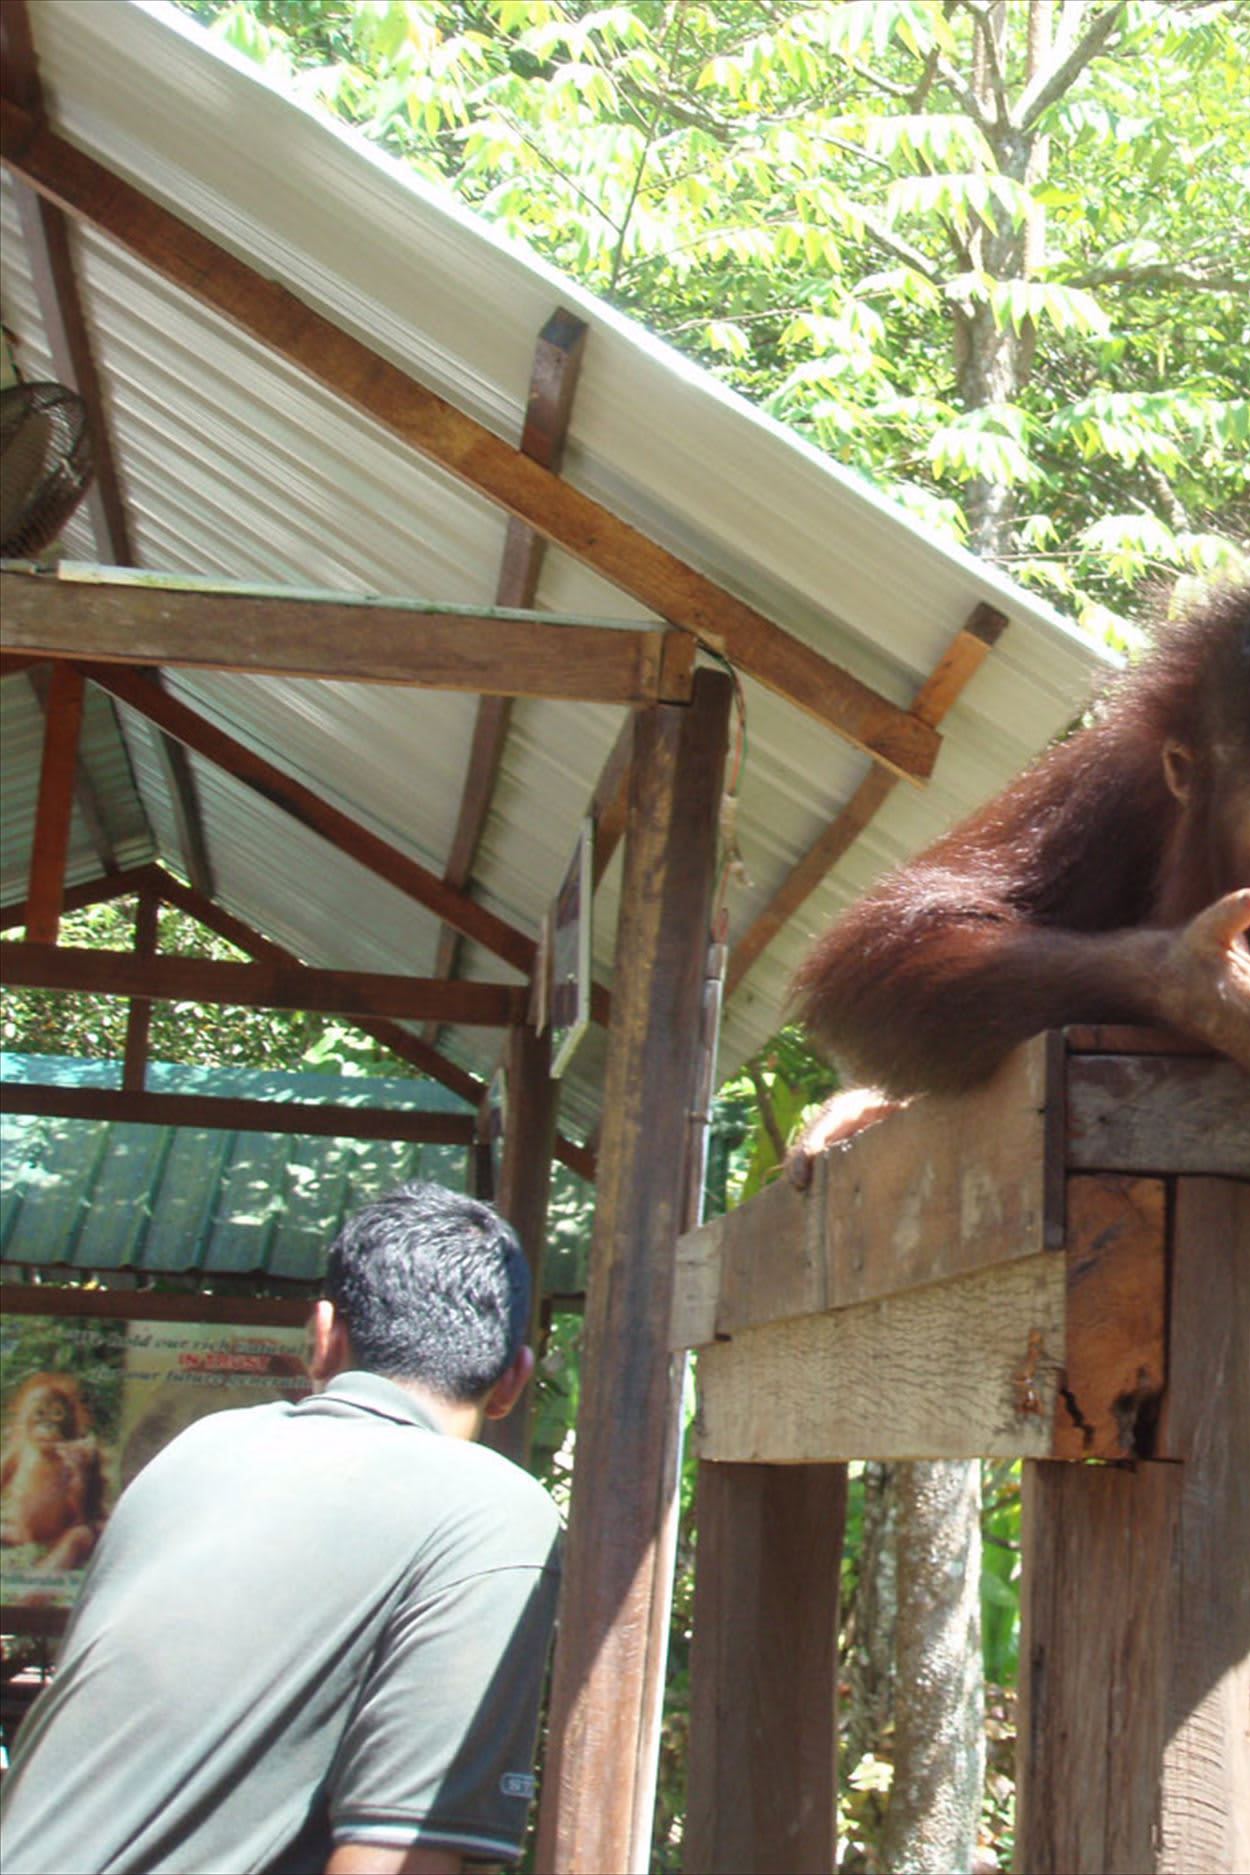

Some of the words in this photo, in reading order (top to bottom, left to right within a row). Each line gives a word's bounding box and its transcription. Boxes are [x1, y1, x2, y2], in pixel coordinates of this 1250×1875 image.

[156, 1339, 189, 1350] our
[193, 1338, 231, 1352] rich
[206, 1354, 269, 1370] TRUST
[164, 1371, 224, 1385] future
